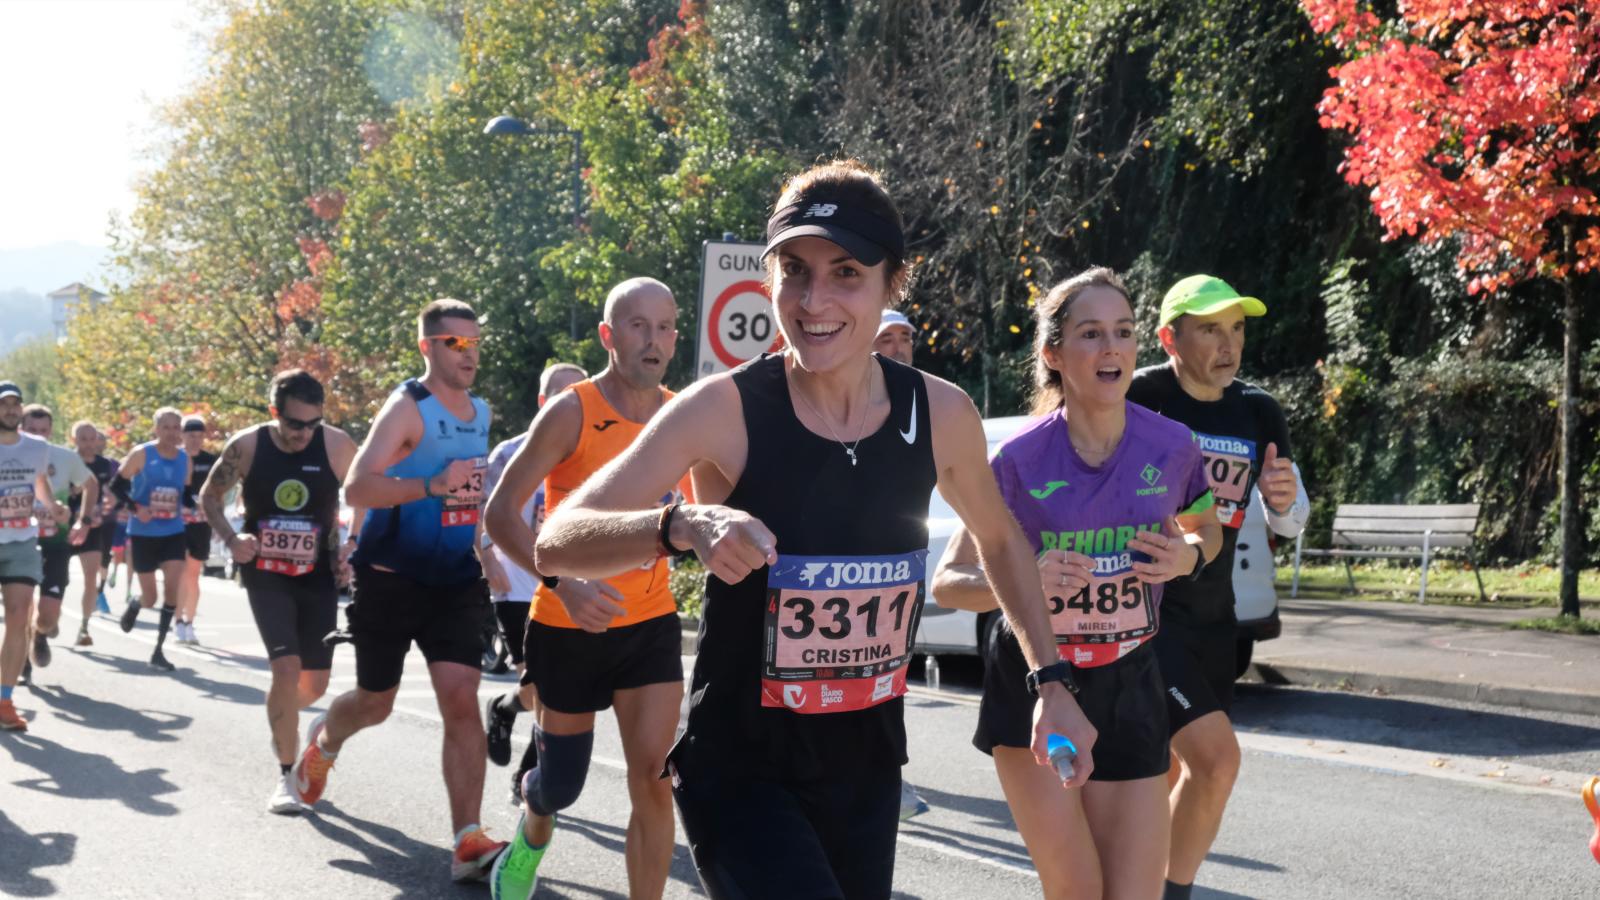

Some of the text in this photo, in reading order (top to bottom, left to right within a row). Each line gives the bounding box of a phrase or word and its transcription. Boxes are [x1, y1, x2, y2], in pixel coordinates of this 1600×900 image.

[719, 254, 767, 272] GUN
[728, 312, 771, 341] 30
[264, 532, 314, 551] 3876
[781, 591, 910, 639] 3311
[1078, 622, 1117, 631] MIREN
[802, 644, 892, 664] CRISTINA
